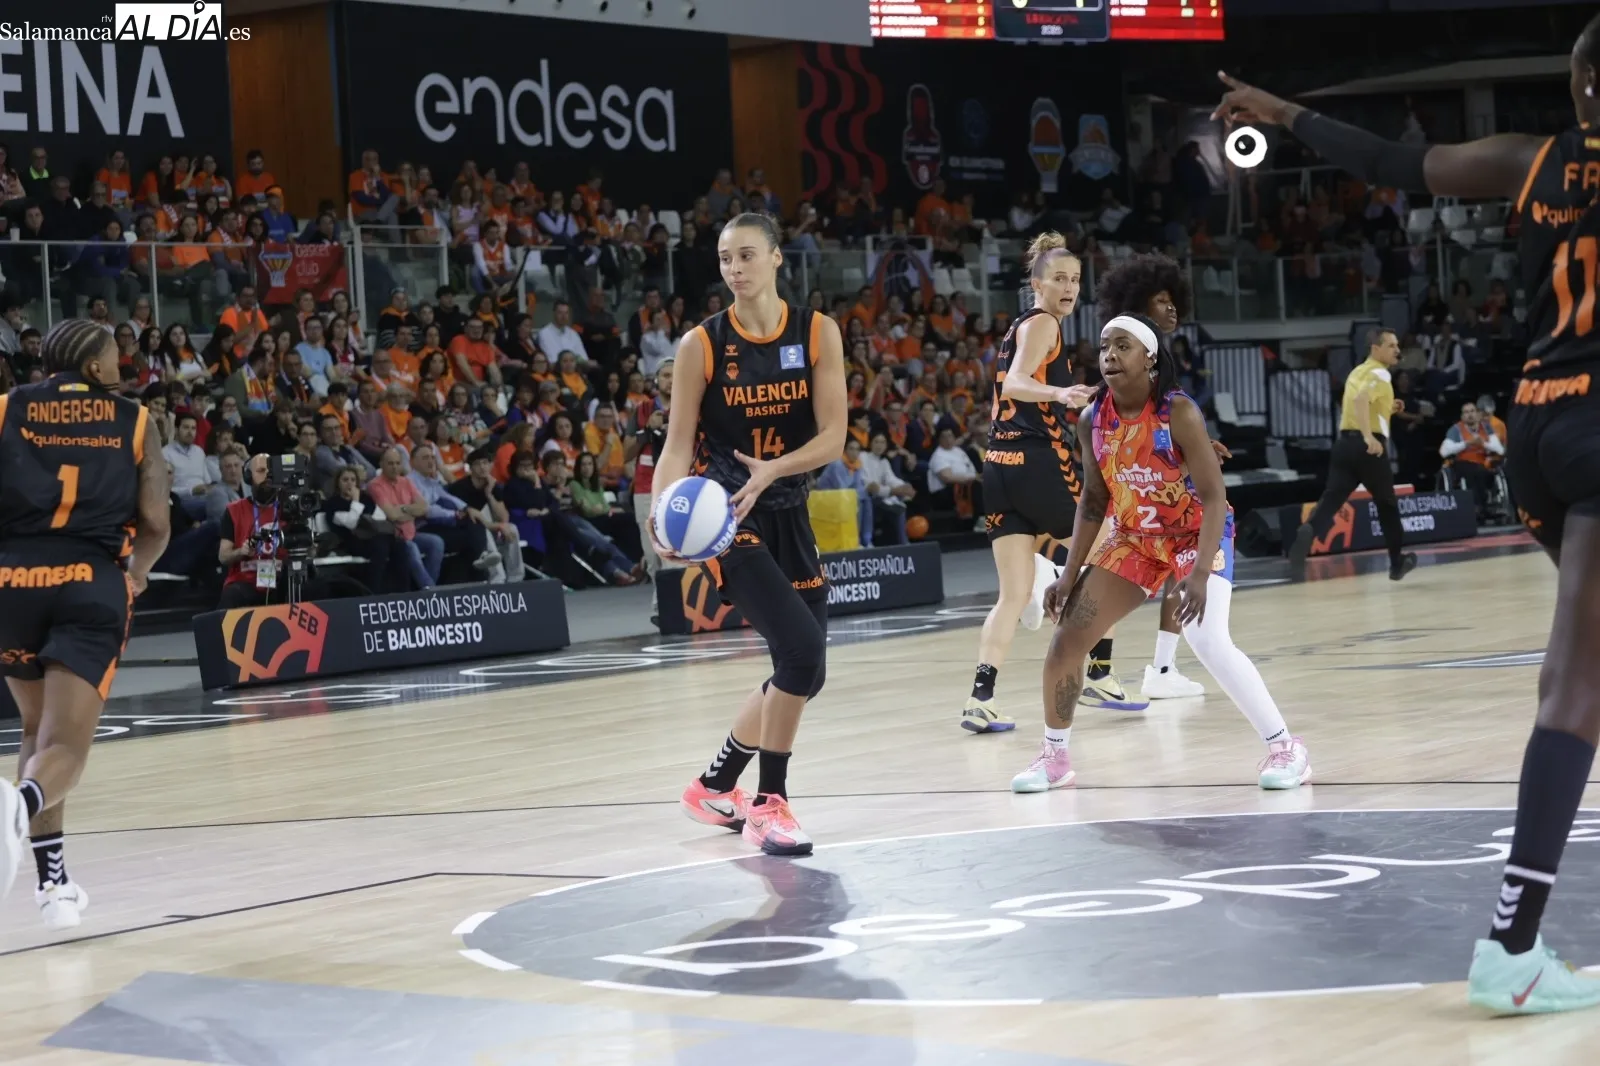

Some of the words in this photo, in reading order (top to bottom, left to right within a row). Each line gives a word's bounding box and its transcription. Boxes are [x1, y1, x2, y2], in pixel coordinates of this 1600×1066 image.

[0, 37, 185, 138] EINA
[415, 59, 677, 152] endesa
[723, 380, 808, 406] VALENCIA
[27, 399, 115, 424] ANDERSON
[745, 403, 791, 418] BASKET
[33, 435, 122, 449] quironsalud
[751, 427, 785, 460] 14
[50, 464, 80, 529] 1
[1137, 505, 1161, 529] 2
[0, 563, 93, 588] PAMESA
[824, 557, 857, 581] ACIÓN
[859, 554, 915, 578] ESPAÑOLA
[827, 581, 880, 604] ONCESTO
[289, 602, 318, 636] FEB
[359, 593, 451, 625] FEDERACIÓN
[453, 591, 528, 617] ESPAÑOLA
[363, 631, 385, 654] DE
[388, 622, 483, 651] BALONCESTO
